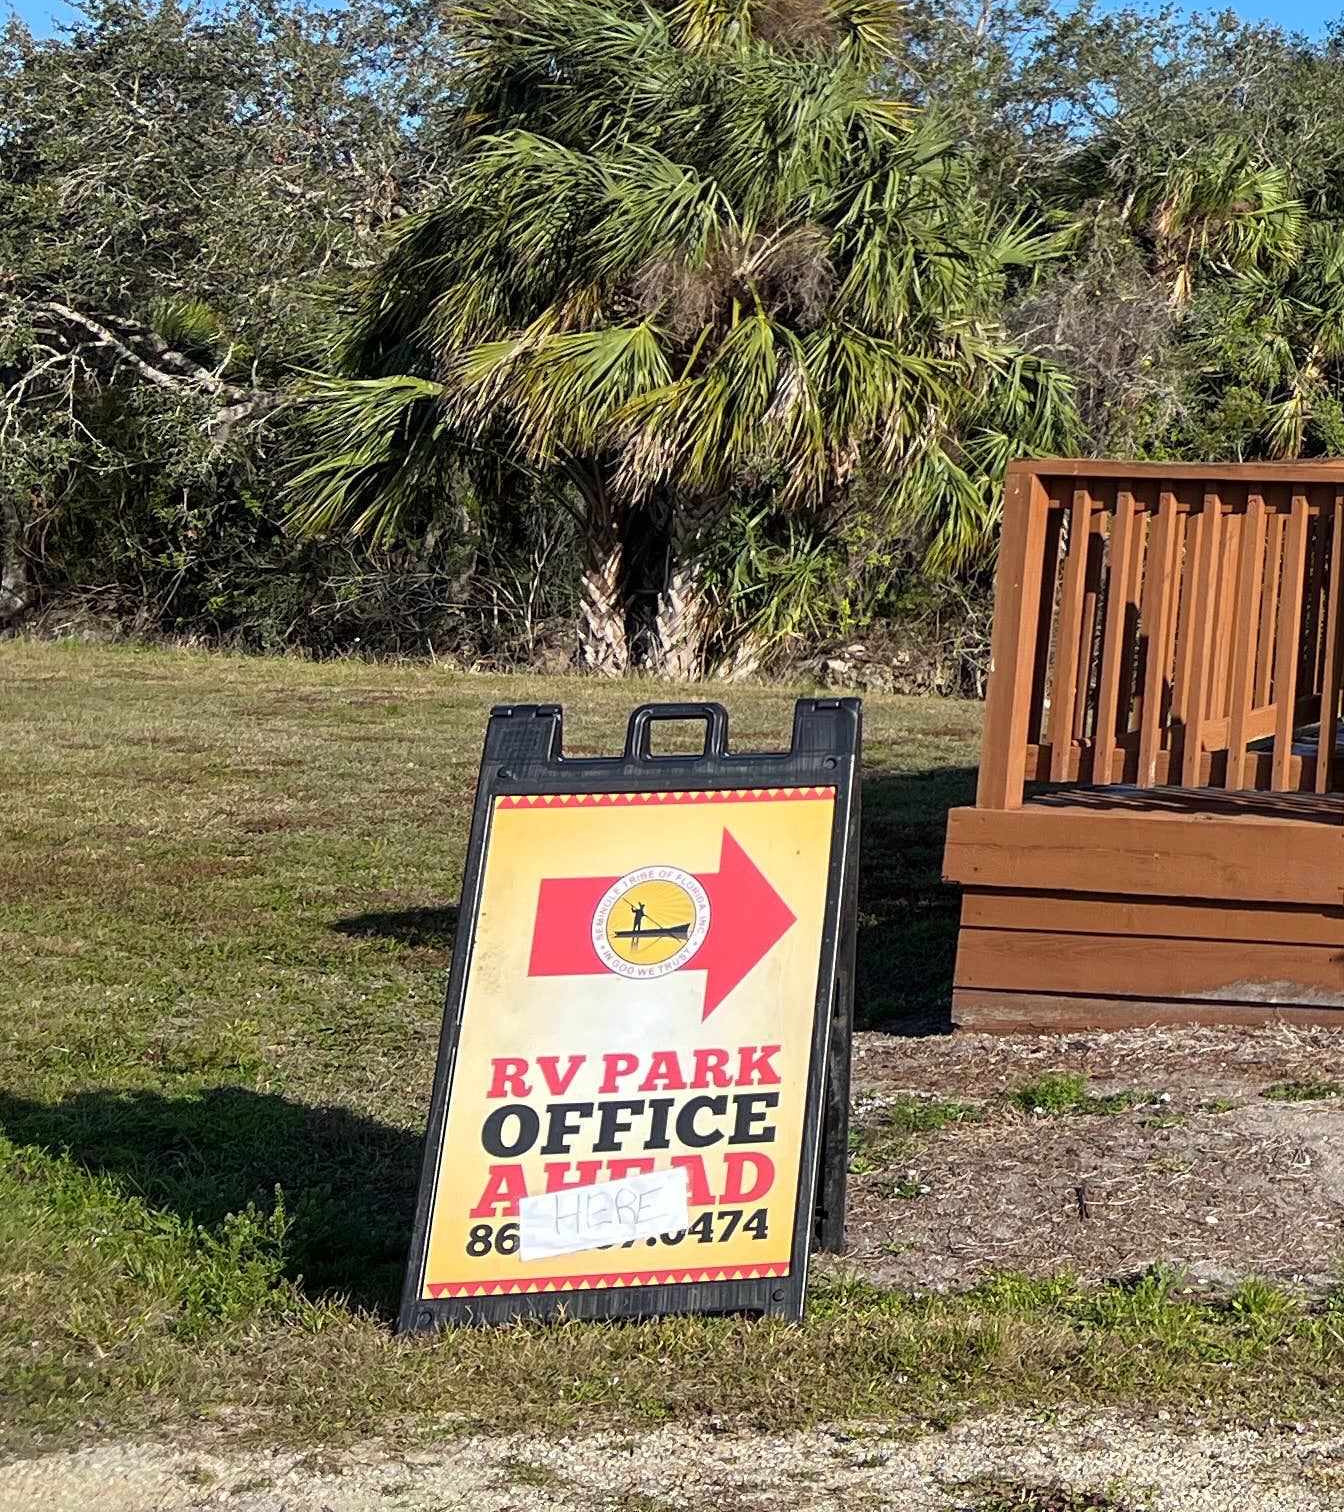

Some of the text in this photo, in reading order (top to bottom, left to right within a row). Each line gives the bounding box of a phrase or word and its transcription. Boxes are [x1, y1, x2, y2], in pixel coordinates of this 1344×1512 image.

[595, 888, 621, 941] SEMINOLE
[621, 870, 655, 888] TRIBE
[658, 870, 674, 880] OF
[675, 873, 706, 913] FLORIDA
[602, 950, 613, 962] IN
[638, 967, 655, 977] WE
[658, 948, 691, 974] TRUST
[486, 1044, 782, 1099] RV PARK
[481, 1092, 780, 1158] OFFICE
[555, 1185, 670, 1236] HERE
